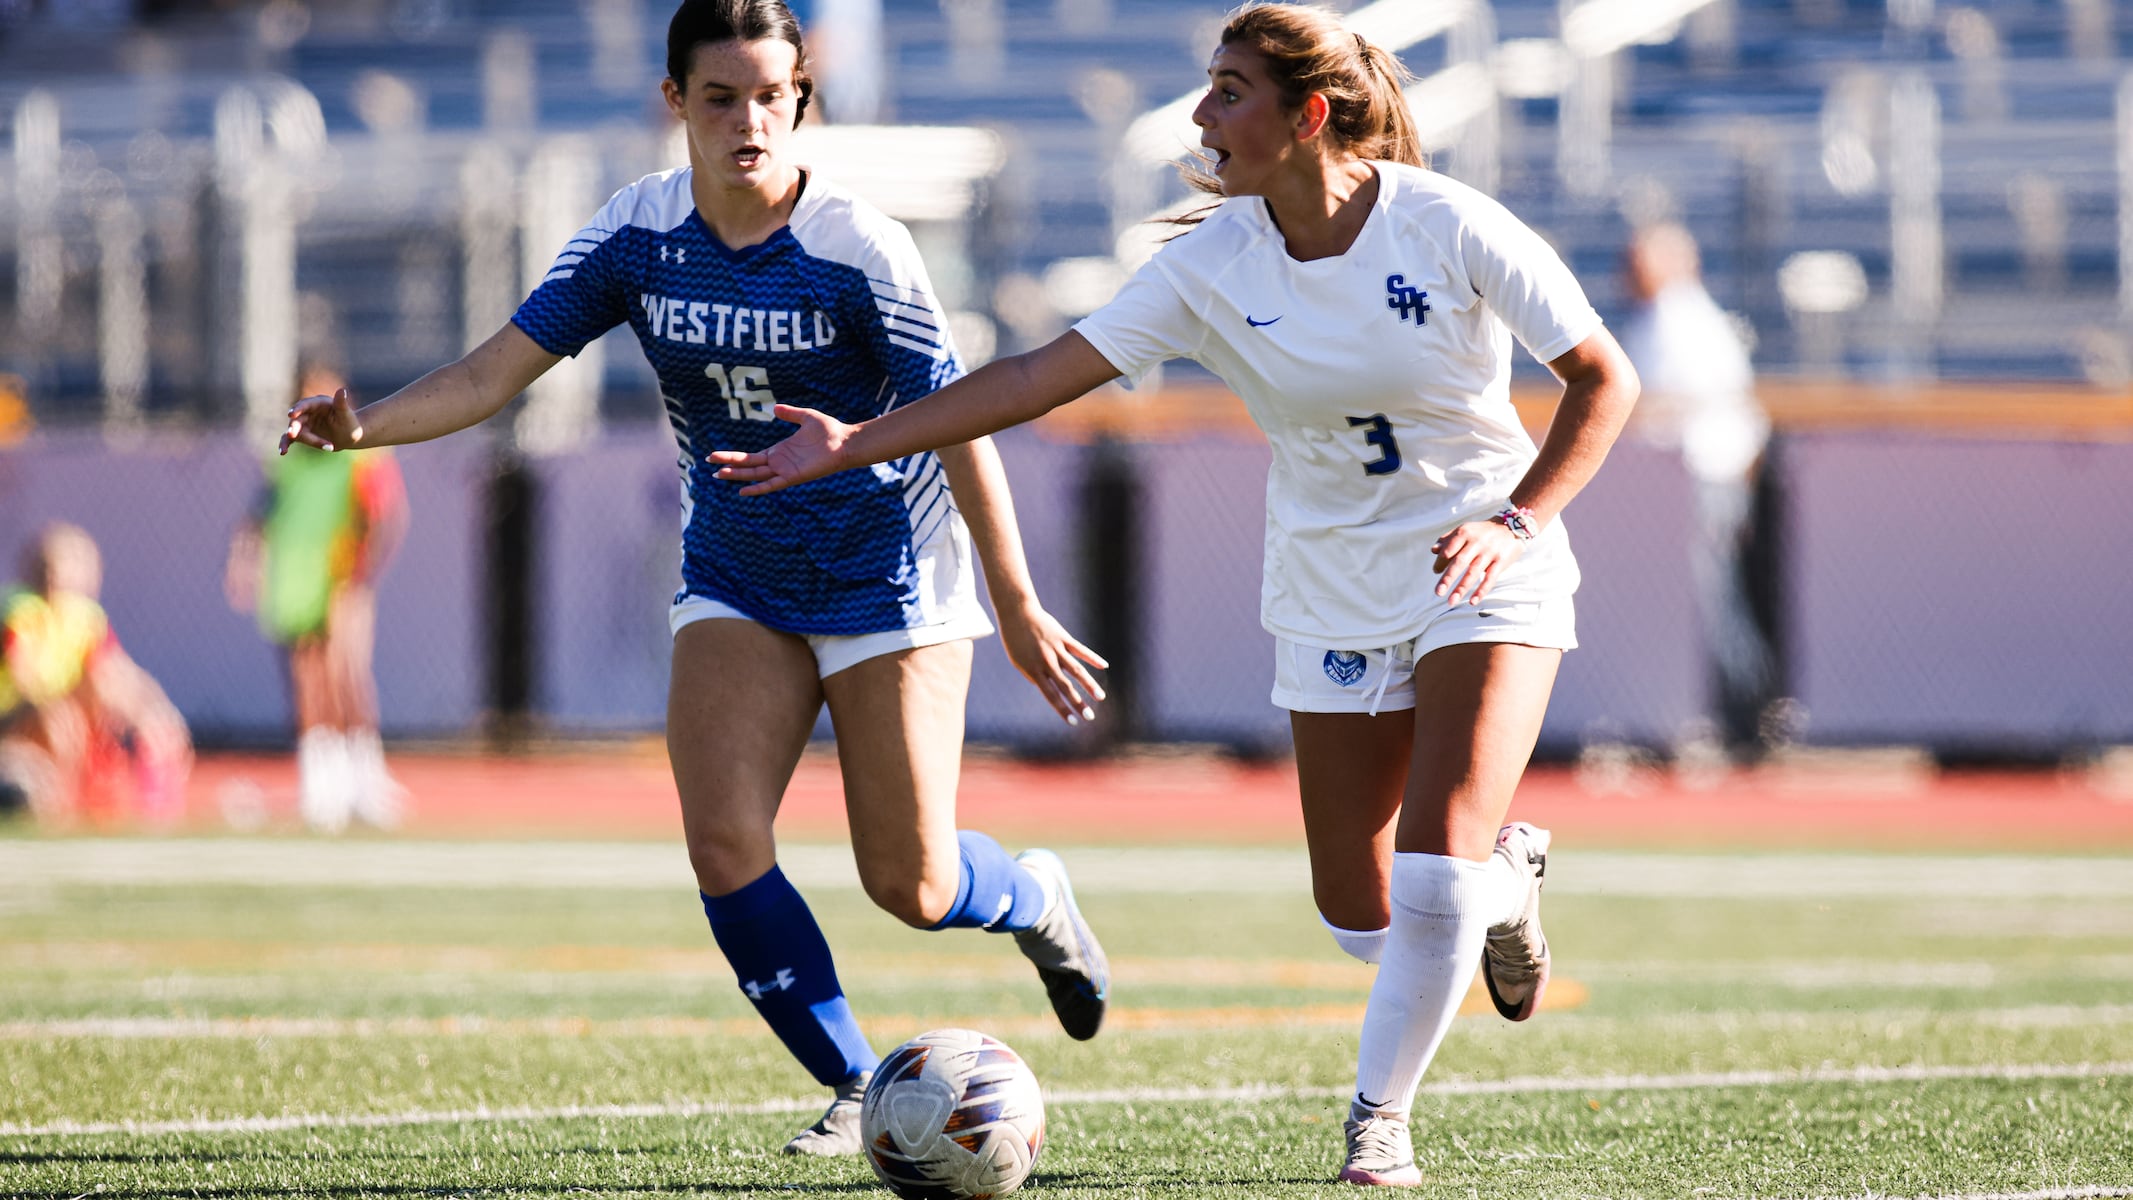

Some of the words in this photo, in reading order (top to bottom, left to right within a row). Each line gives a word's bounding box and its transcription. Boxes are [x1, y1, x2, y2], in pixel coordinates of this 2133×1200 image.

[641, 293, 836, 352] WESTFIELD
[1386, 273, 1431, 327] SPF
[704, 362, 776, 422] 16
[1345, 413, 1402, 476] 3
